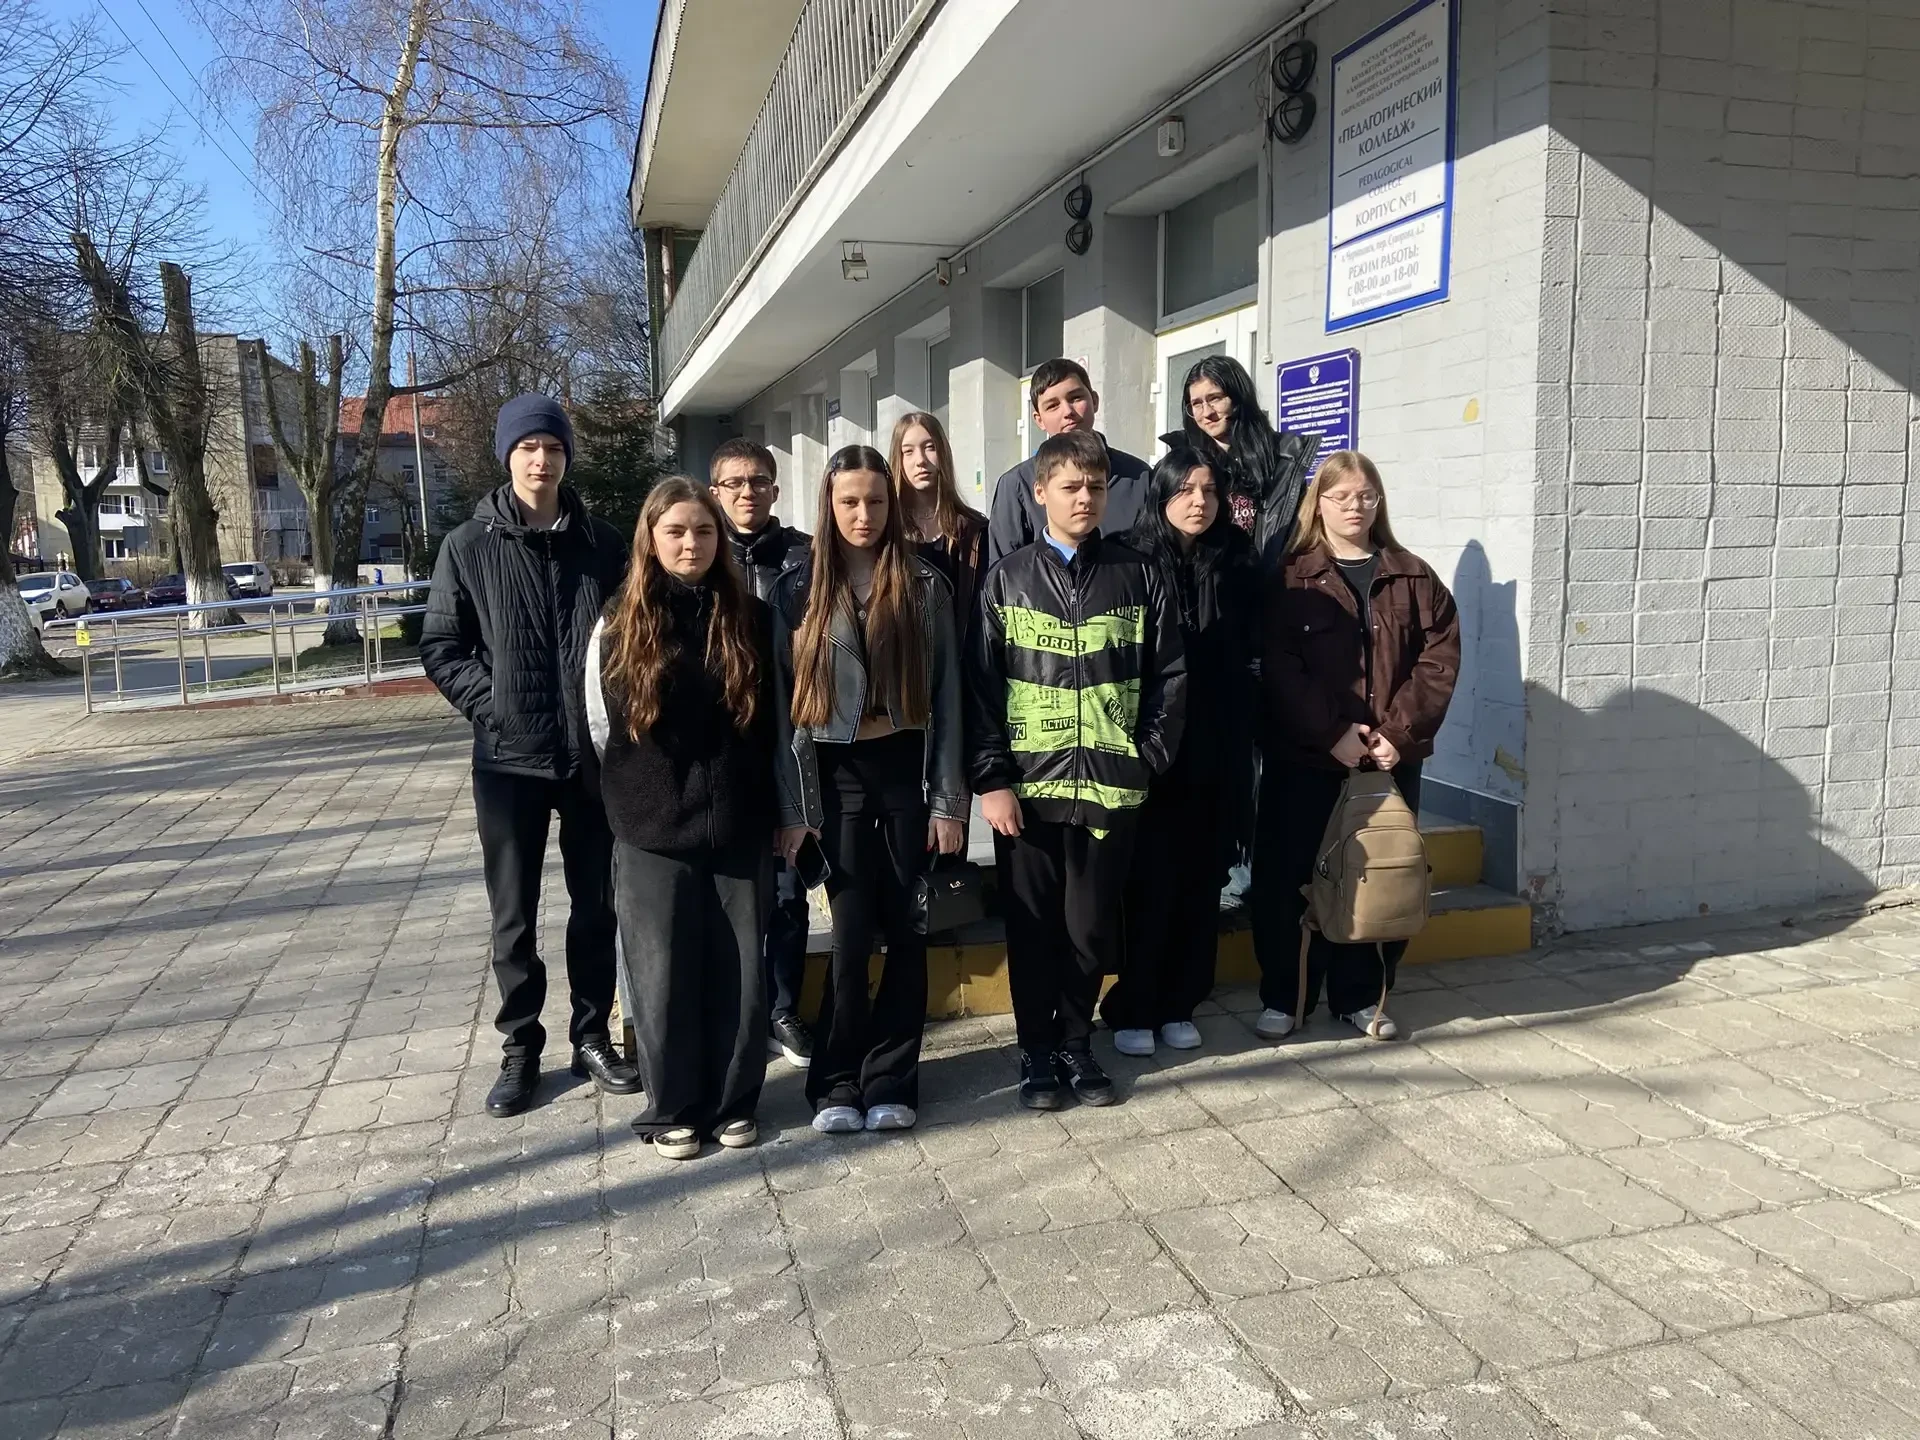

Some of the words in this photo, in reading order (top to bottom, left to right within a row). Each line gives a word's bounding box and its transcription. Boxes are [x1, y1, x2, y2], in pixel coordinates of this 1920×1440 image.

[1338, 76, 1442, 144] «ПЕДАГОГИЧЕСКИЙ
[1359, 118, 1415, 156] КОЛЛЕДЖ»
[1359, 155, 1413, 188] PEDAGOGICAL
[1369, 175, 1403, 198] COLLEGE
[1356, 198, 1397, 227] КОРПУС
[1348, 258, 1379, 280] РЕЖИМ
[1381, 244, 1419, 268] РАБОТЫ:
[1380, 274, 1391, 287] до
[1394, 261, 1419, 282] 18-00
[1235, 509, 1257, 519] LOV
[1039, 635, 1084, 651] ORDER
[1042, 717, 1075, 730] ACTIVE
